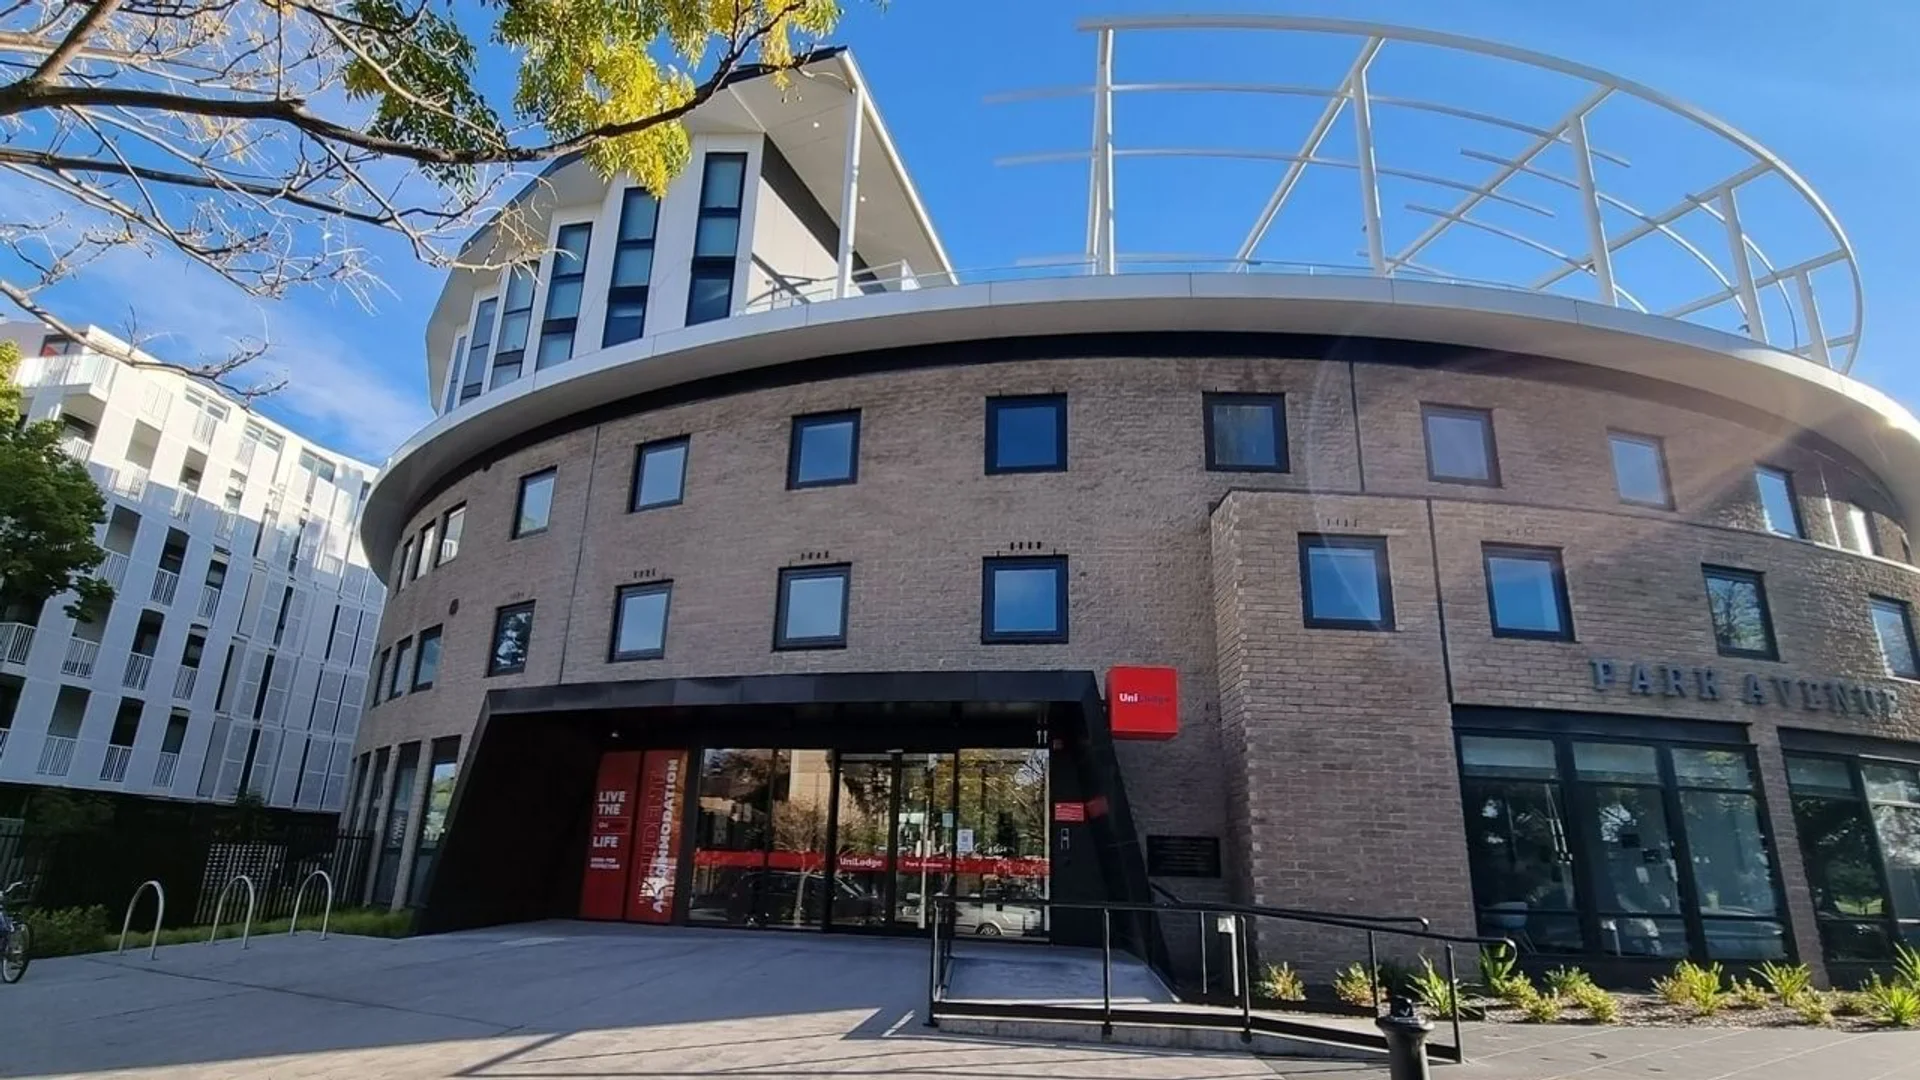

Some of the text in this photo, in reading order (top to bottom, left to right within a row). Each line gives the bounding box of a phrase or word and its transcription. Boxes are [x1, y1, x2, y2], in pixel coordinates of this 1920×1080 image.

[1589, 659, 1901, 719] PARK AVENUE
[599, 790, 625, 802] LIVE
[598, 803, 620, 815] THE
[592, 836, 618, 848] LIFE
[652, 758, 679, 914] ACOMMODATION
[840, 857, 883, 868] UniLodge
